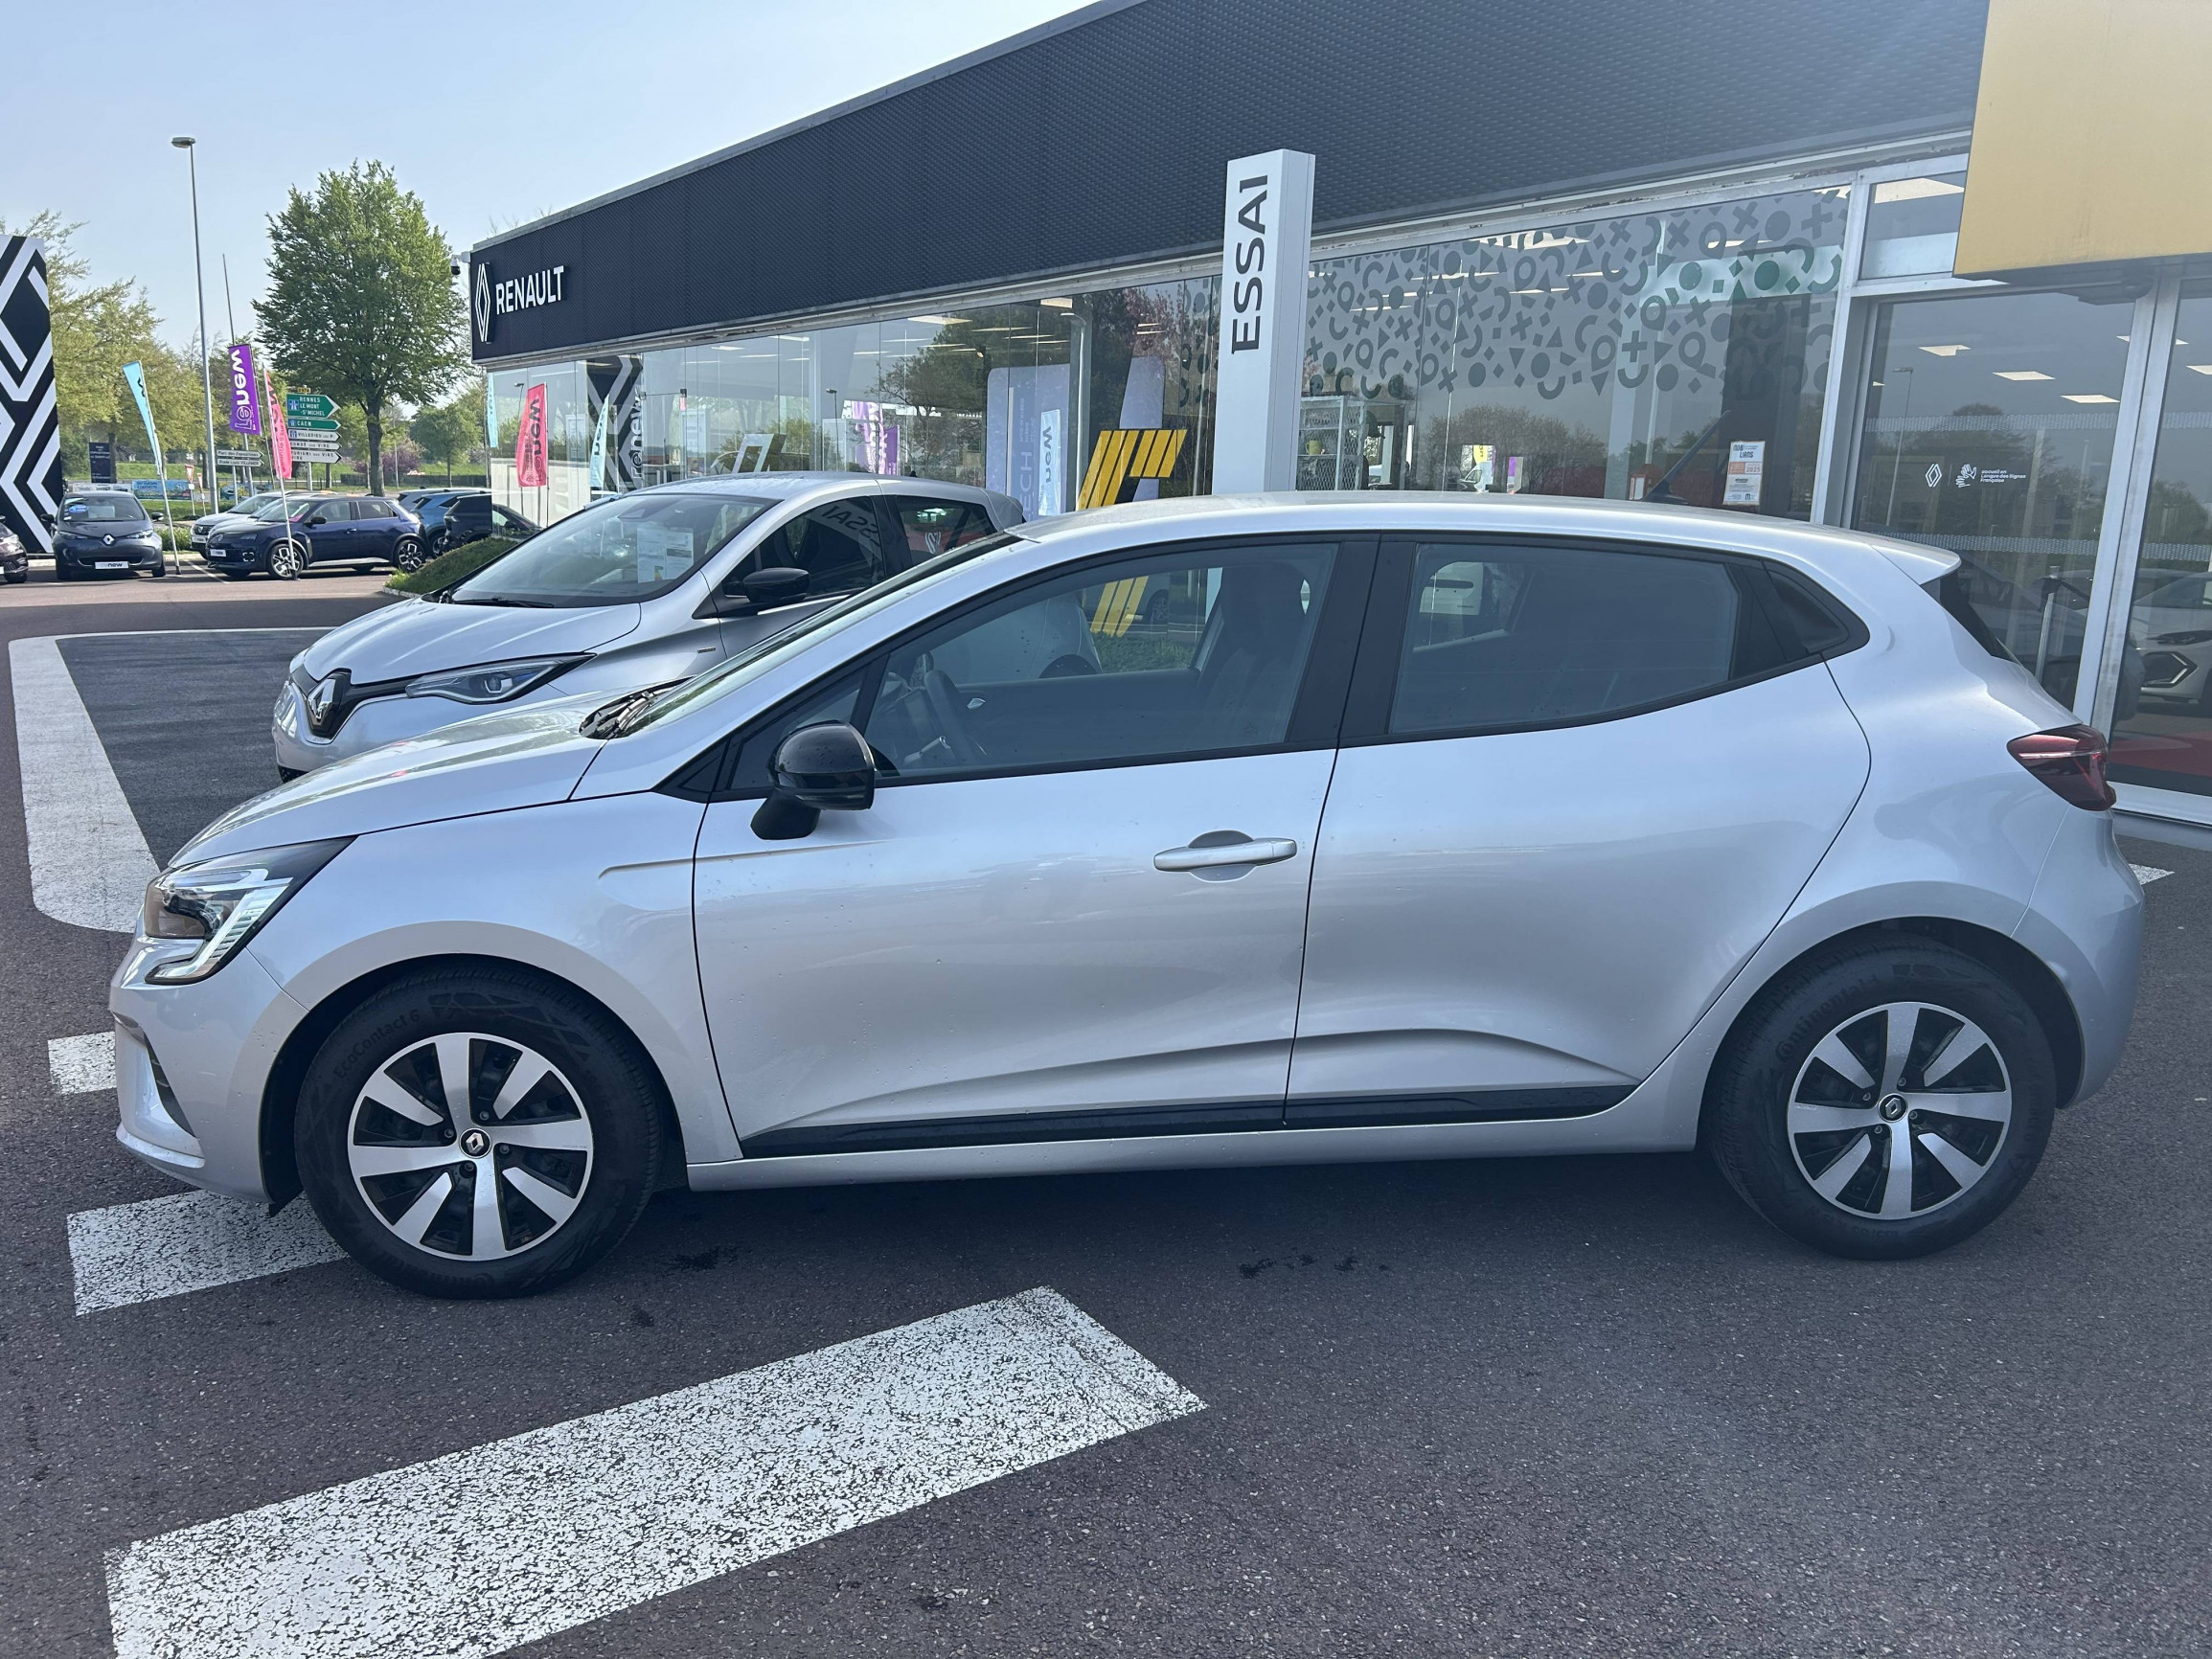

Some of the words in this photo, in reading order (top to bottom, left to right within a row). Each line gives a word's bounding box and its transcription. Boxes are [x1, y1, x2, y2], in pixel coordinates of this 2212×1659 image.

[495, 265, 564, 315] RENAULT
[1231, 175, 1268, 354] ESSAI
[332, 1015, 408, 1079] EcoContact
[409, 1009, 421, 1022] 6
